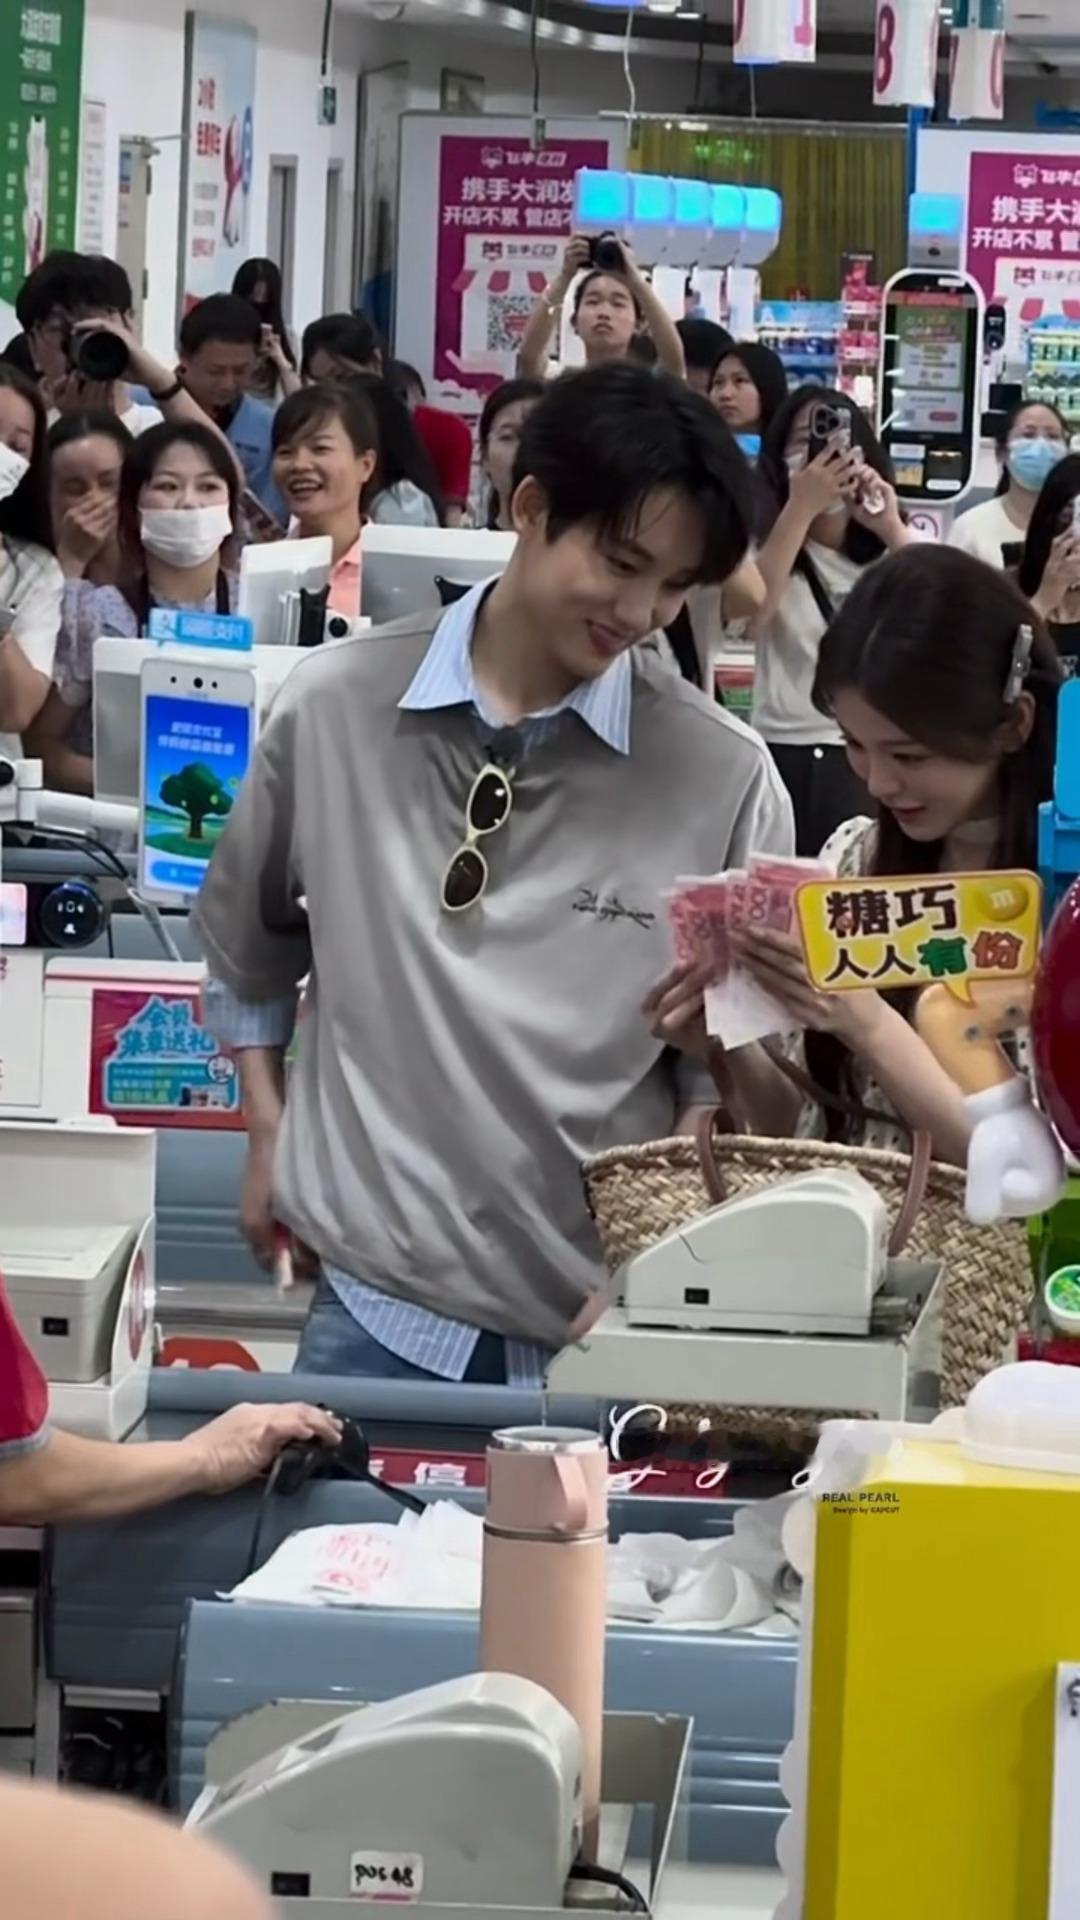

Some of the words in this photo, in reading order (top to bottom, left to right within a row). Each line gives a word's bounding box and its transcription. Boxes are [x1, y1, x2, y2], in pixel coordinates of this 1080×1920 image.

[826, 883, 957, 938] 糖巧
[825, 931, 1023, 982] 人人有份
